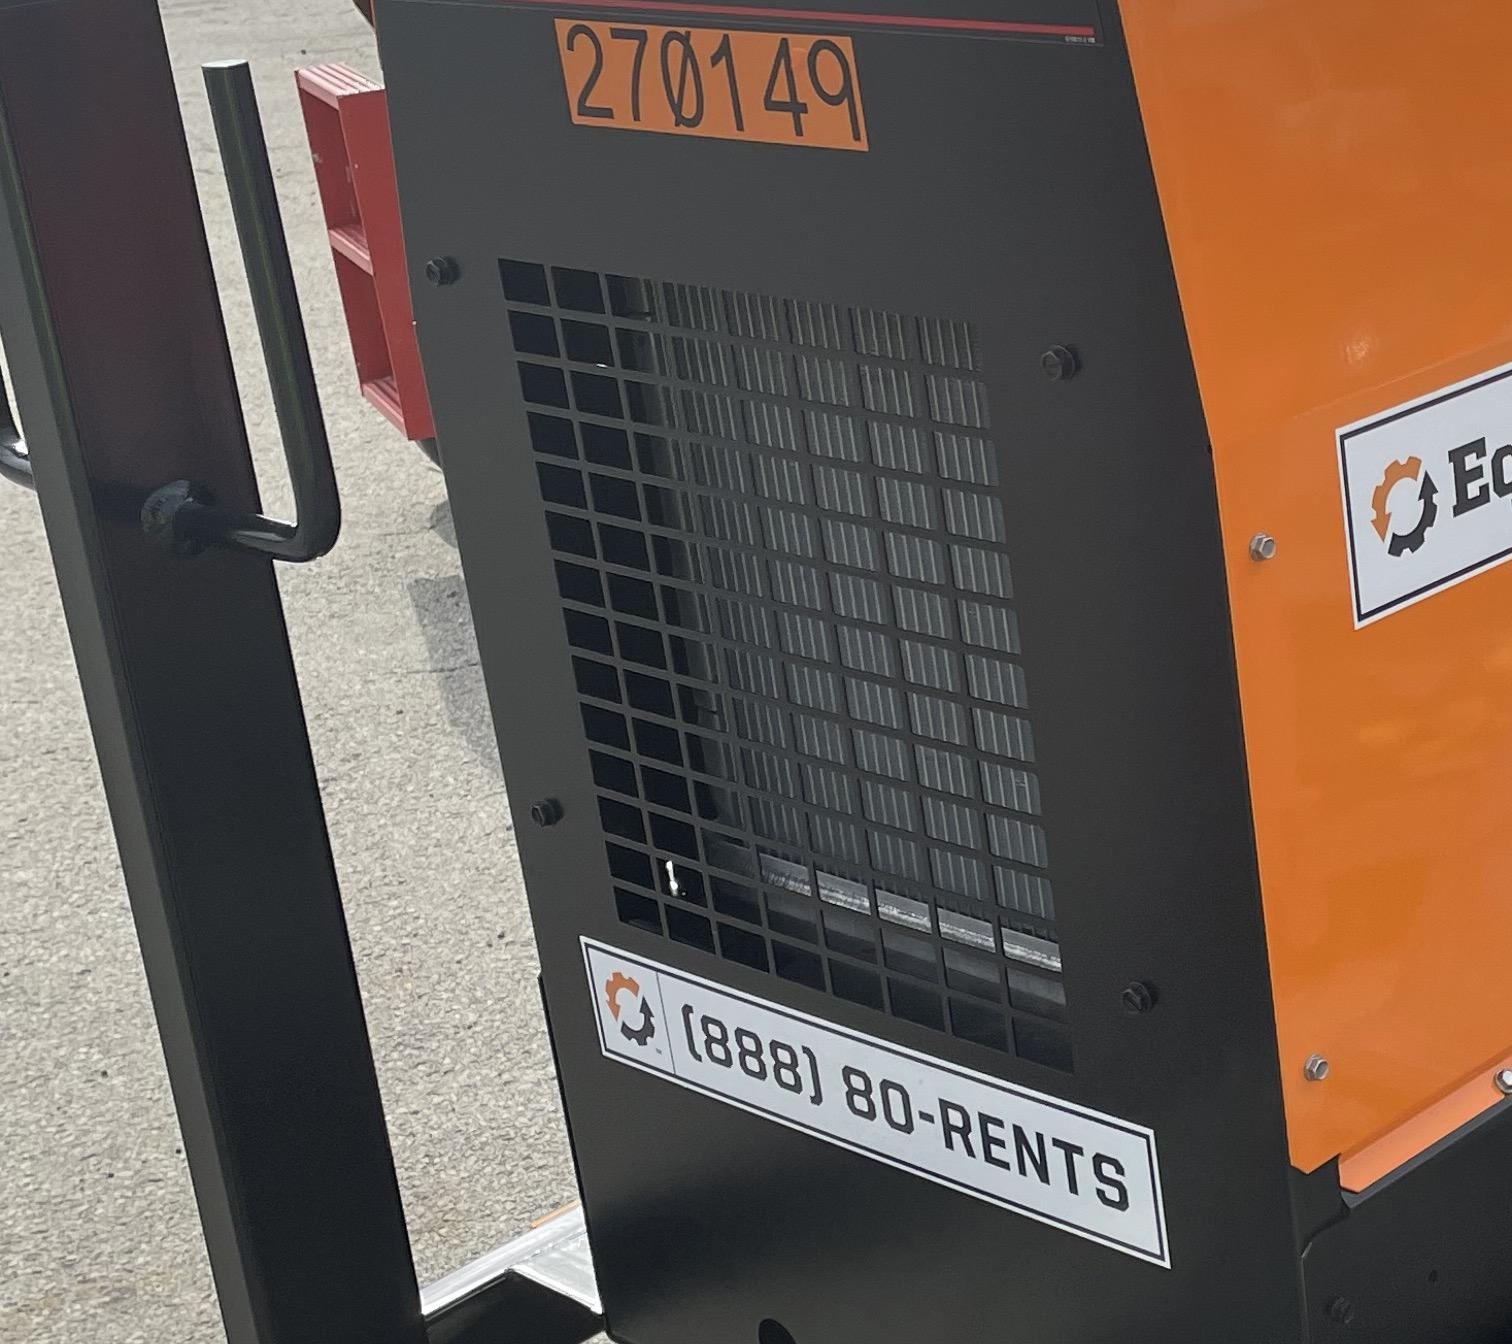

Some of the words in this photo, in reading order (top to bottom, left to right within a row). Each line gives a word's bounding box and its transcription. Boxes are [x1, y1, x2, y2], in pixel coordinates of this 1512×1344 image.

[566, 24, 862, 143] 270149
[681, 1003, 823, 1106] (888)
[841, 1064, 1131, 1213] 80-RENTS
